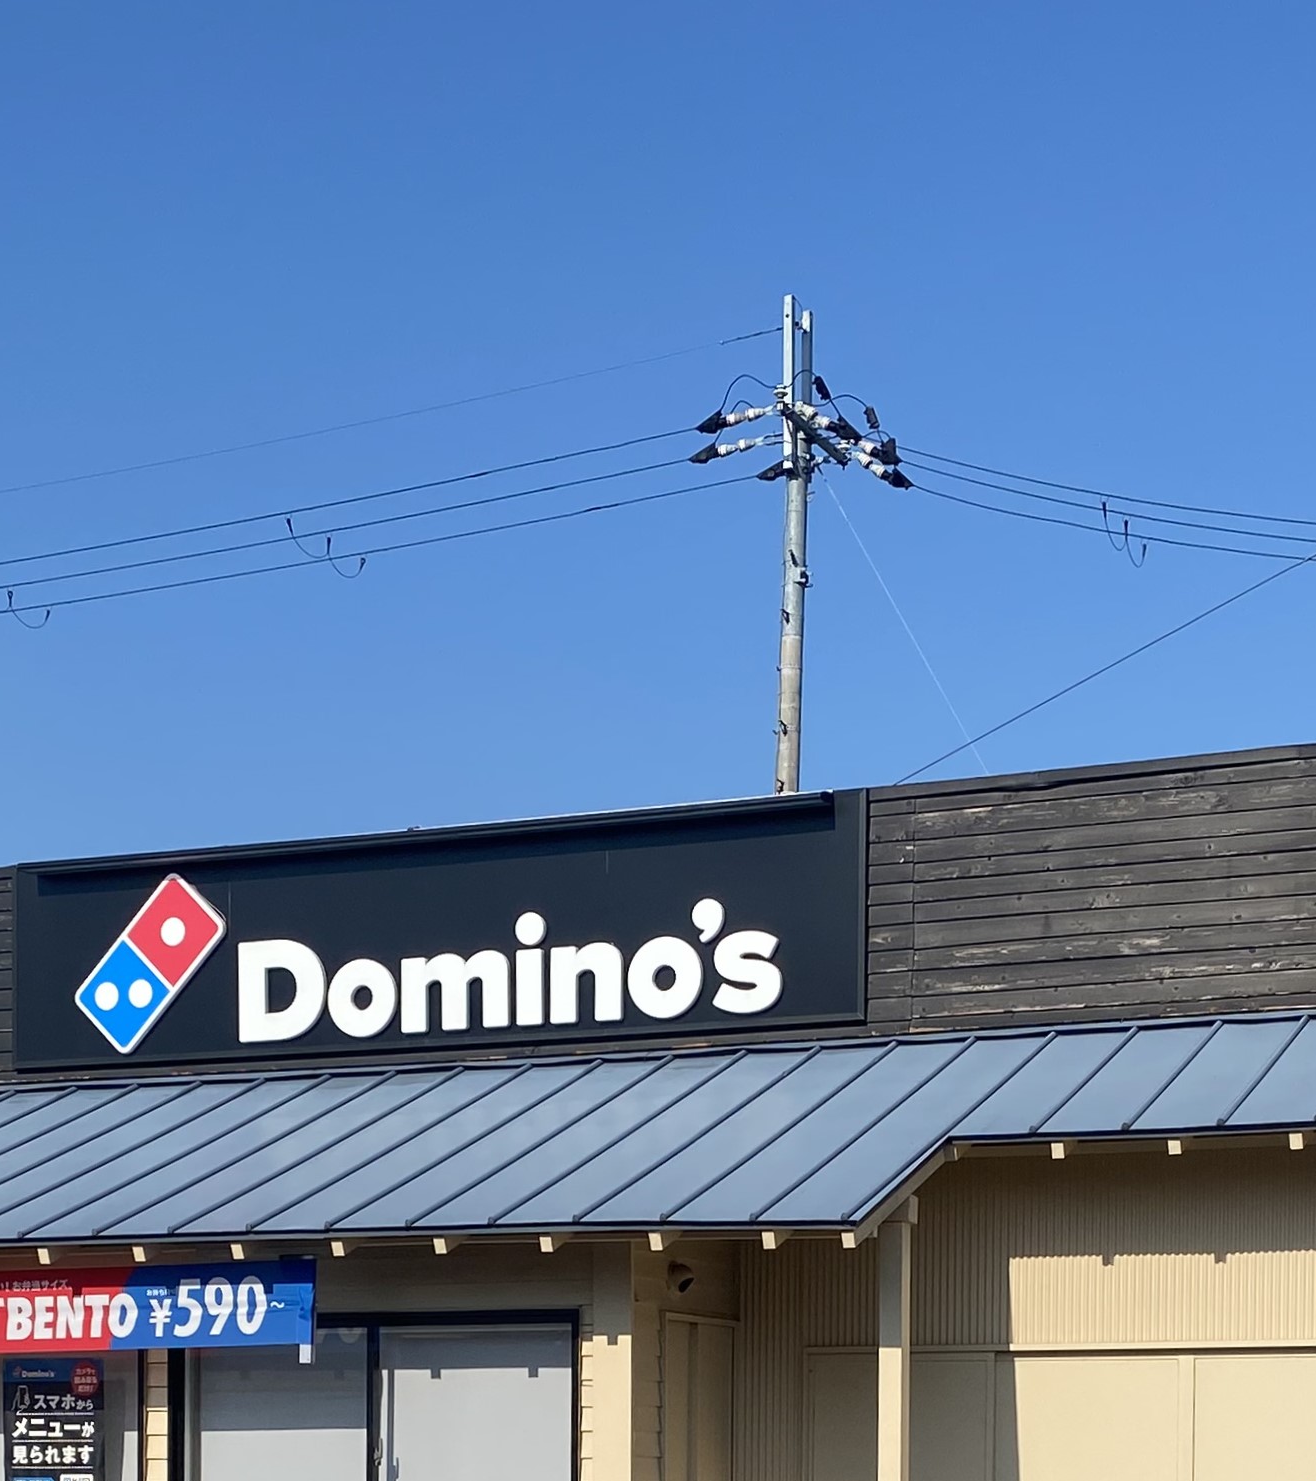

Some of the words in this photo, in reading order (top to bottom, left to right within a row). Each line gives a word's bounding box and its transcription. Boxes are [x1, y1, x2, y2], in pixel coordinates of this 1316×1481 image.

[238, 898, 784, 1043] Domino's
[33, 1393, 94, 1411] スマホから
[11, 1417, 95, 1438] メニューが
[11, 1444, 94, 1465] 見られます
